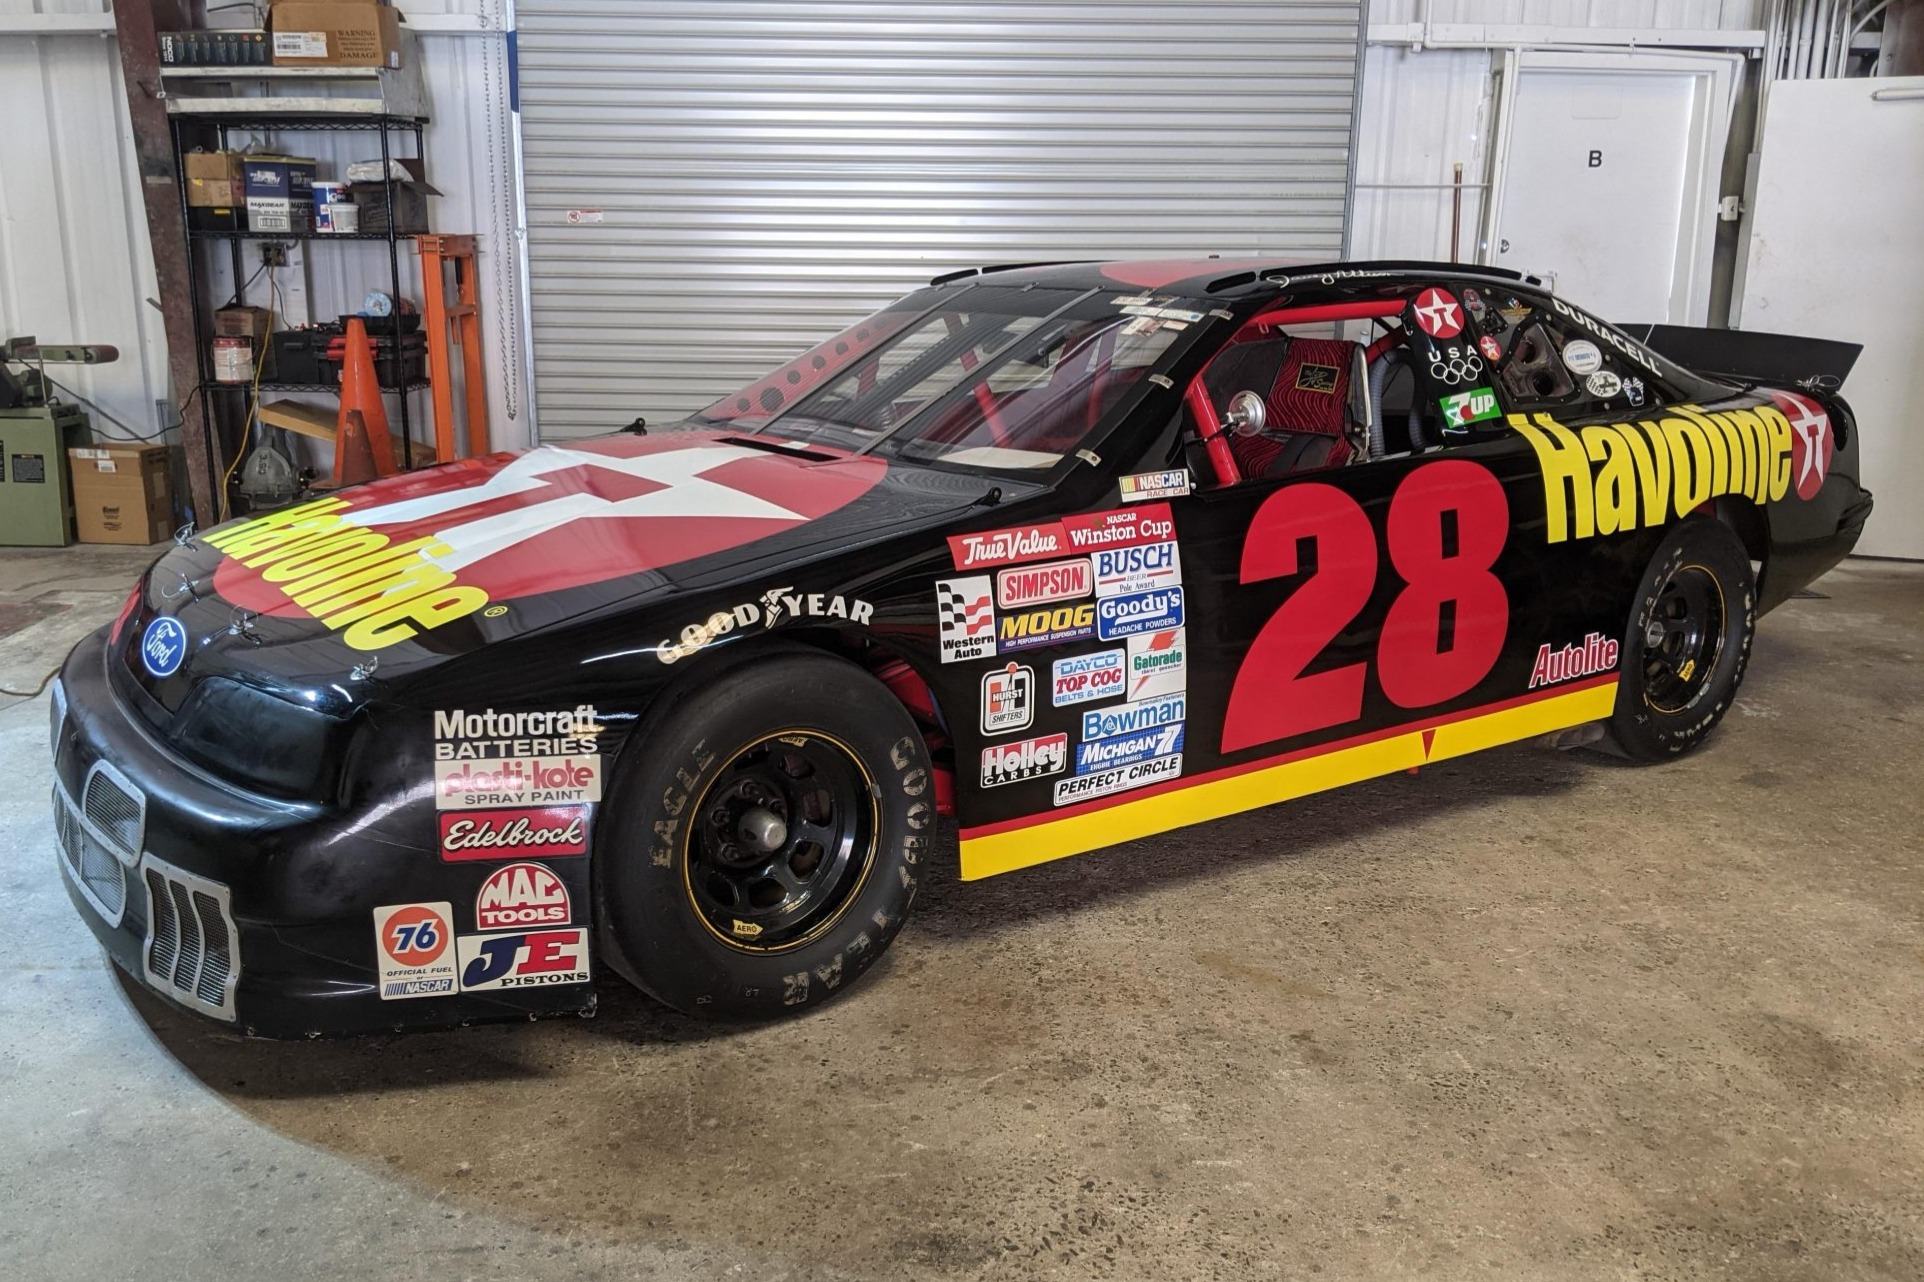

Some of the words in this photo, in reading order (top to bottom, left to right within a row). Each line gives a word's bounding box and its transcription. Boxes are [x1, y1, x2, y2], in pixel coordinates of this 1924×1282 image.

[1588, 150, 1602, 168] B
[1551, 296, 1663, 377] DURACELL
[1139, 471, 1183, 490] NASCAR
[1507, 404, 1793, 544] Havoline
[1146, 489, 1168, 498] RACE
[1172, 487, 1189, 495] CAR
[1106, 513, 1137, 524] NASCAR
[1070, 525, 1137, 547] Winston
[1140, 520, 1172, 539] Cup
[1098, 543, 1173, 576] BUSCH
[202, 496, 489, 651] Havoline
[1005, 566, 1084, 601] SIMPSON
[1127, 574, 1147, 582] BEER
[1119, 583, 1133, 593] Pole
[1135, 580, 1155, 589] Award
[1101, 591, 1181, 625] Goody's
[1221, 459, 1509, 754] 28
[1000, 604, 1095, 639] MOOG
[1109, 623, 1143, 636] HEADACHE
[1145, 617, 1177, 629] POWDERS
[147, 621, 178, 667] Ford
[943, 635, 995, 651] Western
[1005, 639, 1016, 647] HIGH
[1017, 635, 1049, 646] PERFORMANCE
[1050, 630, 1077, 640] SUSPENSION
[1077, 627, 1091, 635] PARTS
[954, 647, 982, 659] Auto
[1134, 651, 1182, 671] Gatorade
[1528, 632, 1619, 688] Autolite
[1061, 653, 1118, 675] DAYCO
[1056, 675, 1088, 694] TOP
[1091, 668, 1122, 687] COG
[992, 689, 1024, 702] HURST
[1055, 691, 1084, 703] BELTS
[1097, 684, 1123, 695] HOSE
[434, 704, 598, 740] Motorcraft
[991, 711, 1024, 724] SHIFTERS
[1085, 700, 1184, 740] Bowman
[435, 737, 598, 760] BATTERIES
[983, 740, 1065, 777] Holley
[1090, 762, 1111, 771] ENGINE
[1113, 754, 1143, 766] BEARINGS
[444, 759, 594, 797] plasti-kote
[984, 765, 1042, 785] CARBS
[1058, 770, 1125, 796] PERFECT
[1128, 757, 1179, 780] CIRCLE
[464, 793, 525, 805] SPRAY
[531, 790, 584, 802] PAINT
[1058, 790, 1093, 802] PERFORMANCE
[443, 817, 584, 850] Edelbrock
[481, 868, 565, 909] MAC
[482, 907, 566, 924] TOOLS
[391, 919, 439, 954] 76
[737, 923, 757, 934] AERO
[462, 931, 581, 988] JE
[386, 968, 428, 977] OFFICIAL
[500, 971, 589, 987] PISTONS
[403, 979, 452, 994] NASCAR
